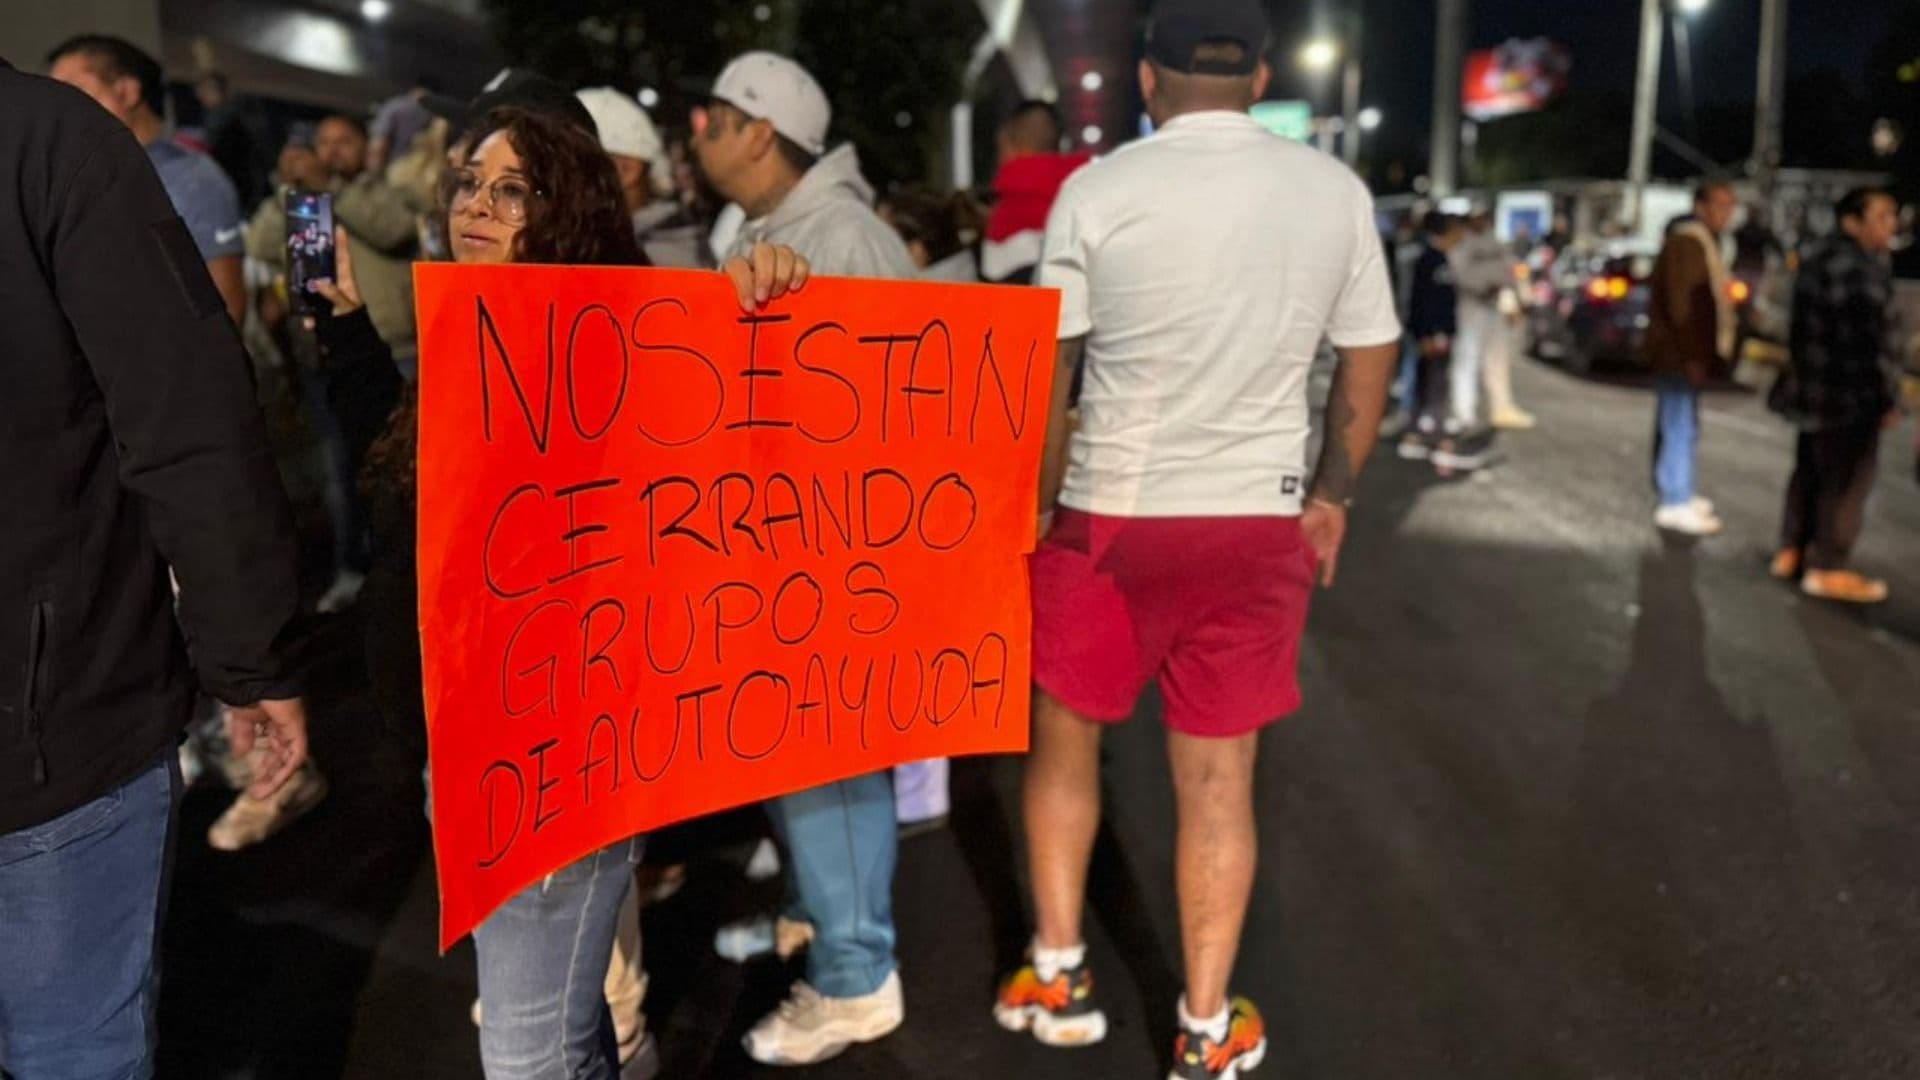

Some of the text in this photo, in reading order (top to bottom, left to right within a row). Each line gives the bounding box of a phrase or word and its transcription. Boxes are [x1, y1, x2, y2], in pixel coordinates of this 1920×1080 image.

[476, 295, 1037, 454] NOS ESTAN
[483, 468, 978, 598] CERRANDO
[502, 561, 900, 717] GRUPOS
